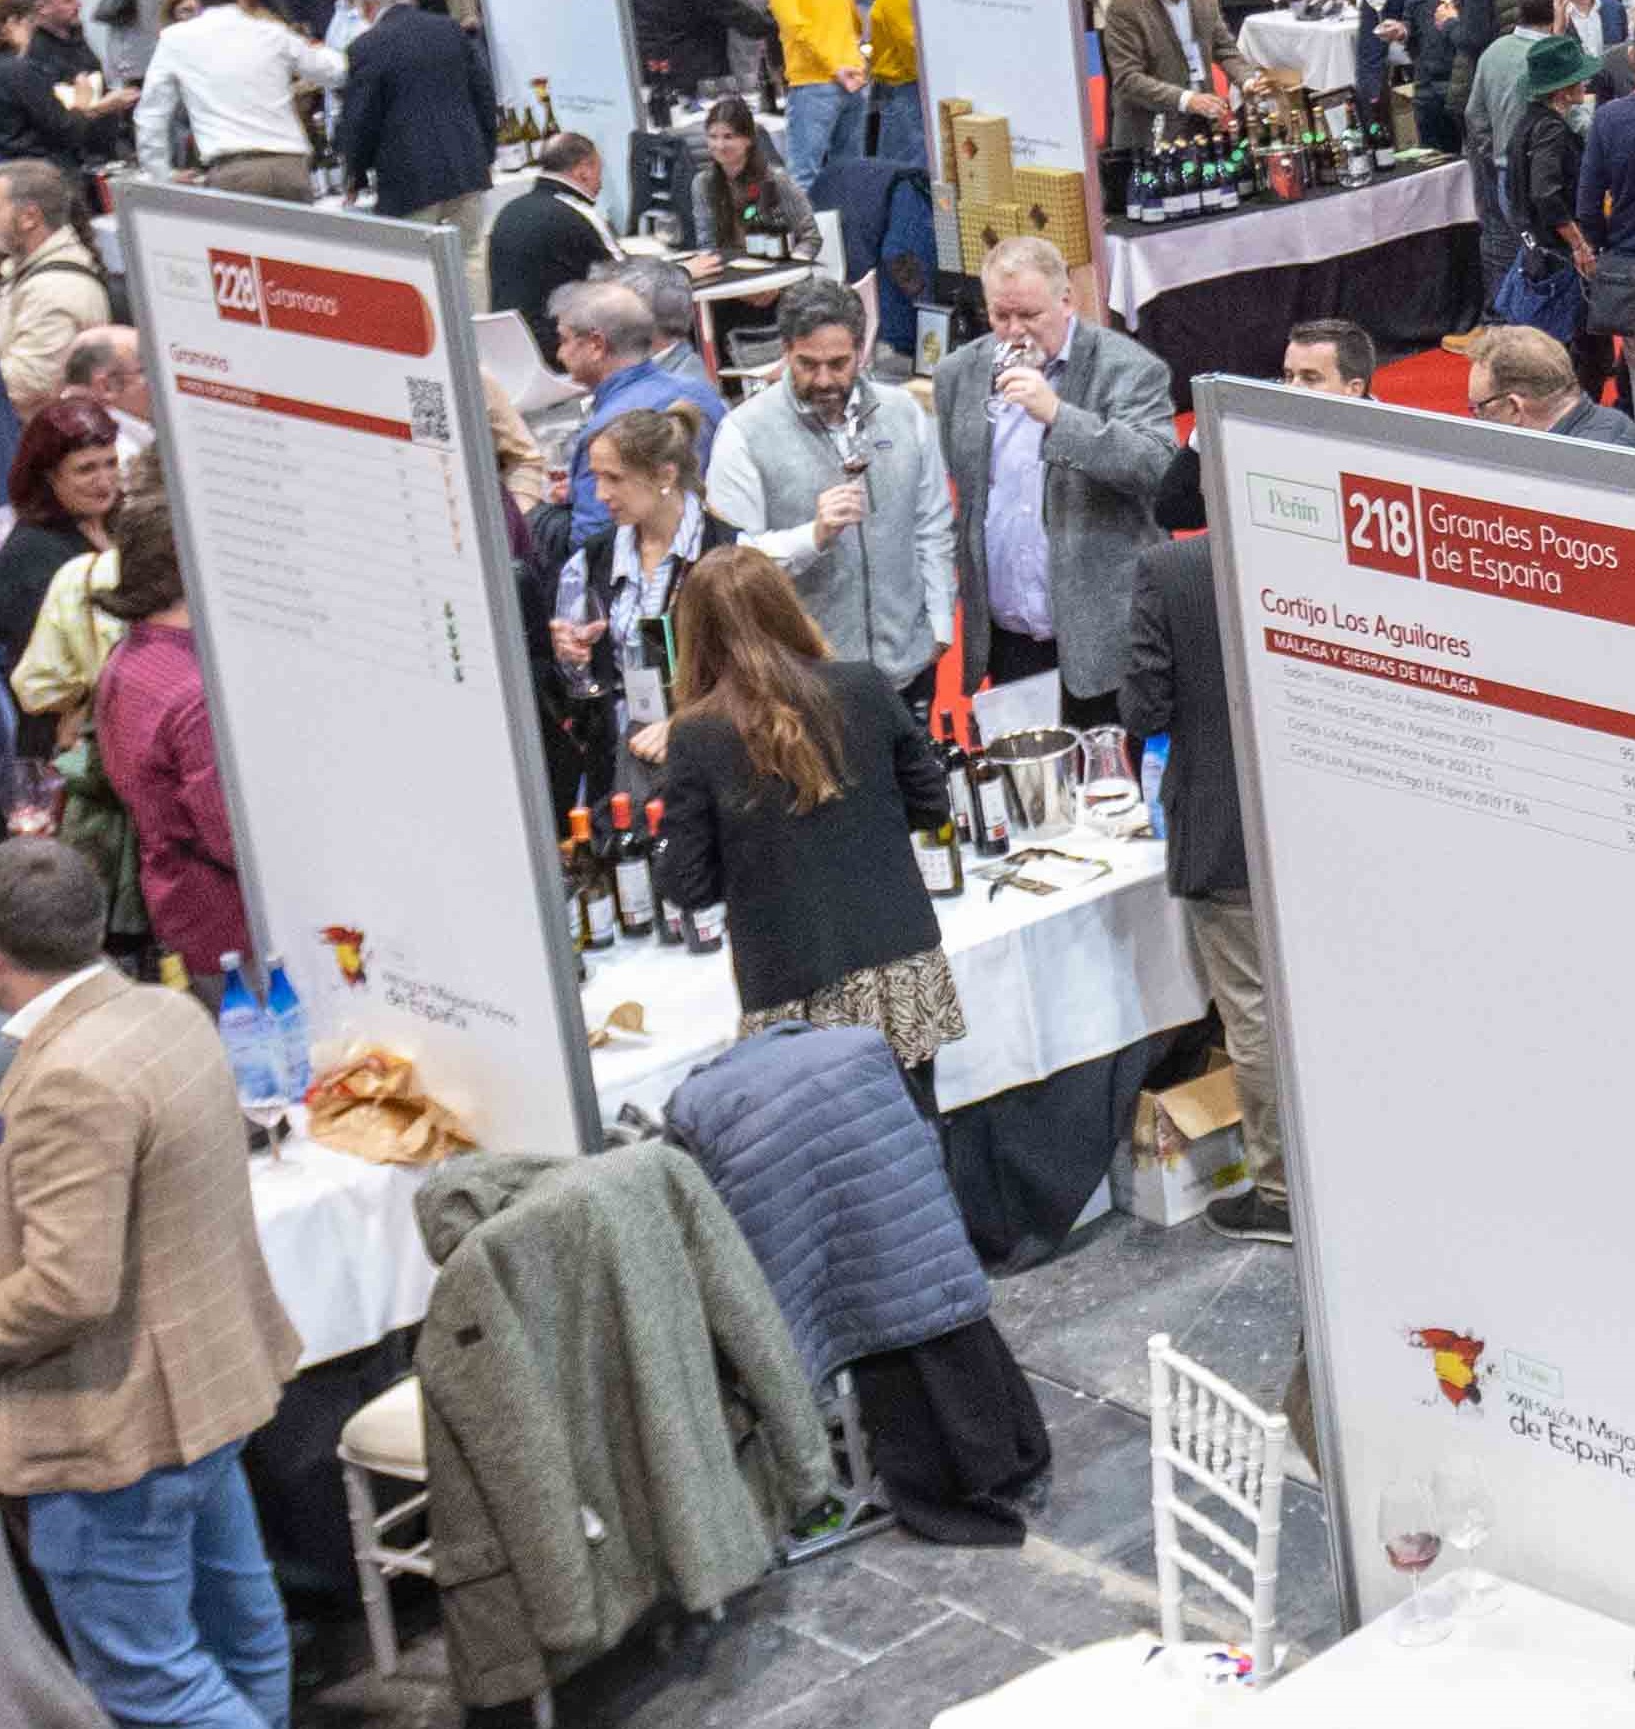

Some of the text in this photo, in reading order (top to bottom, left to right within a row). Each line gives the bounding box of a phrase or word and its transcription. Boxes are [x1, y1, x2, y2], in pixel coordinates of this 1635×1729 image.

[213, 261, 340, 317] 228 Gramona
[1269, 487, 1619, 571] Peñín 218 Grandes Pagos
[1431, 542, 1562, 594] de España
[1260, 587, 1472, 659] Cortijo Los Aguilares
[1273, 633, 1479, 696] MÁLAGA Y SIERRAS DE MÁLAGA
[1508, 1411, 1543, 1441] de
